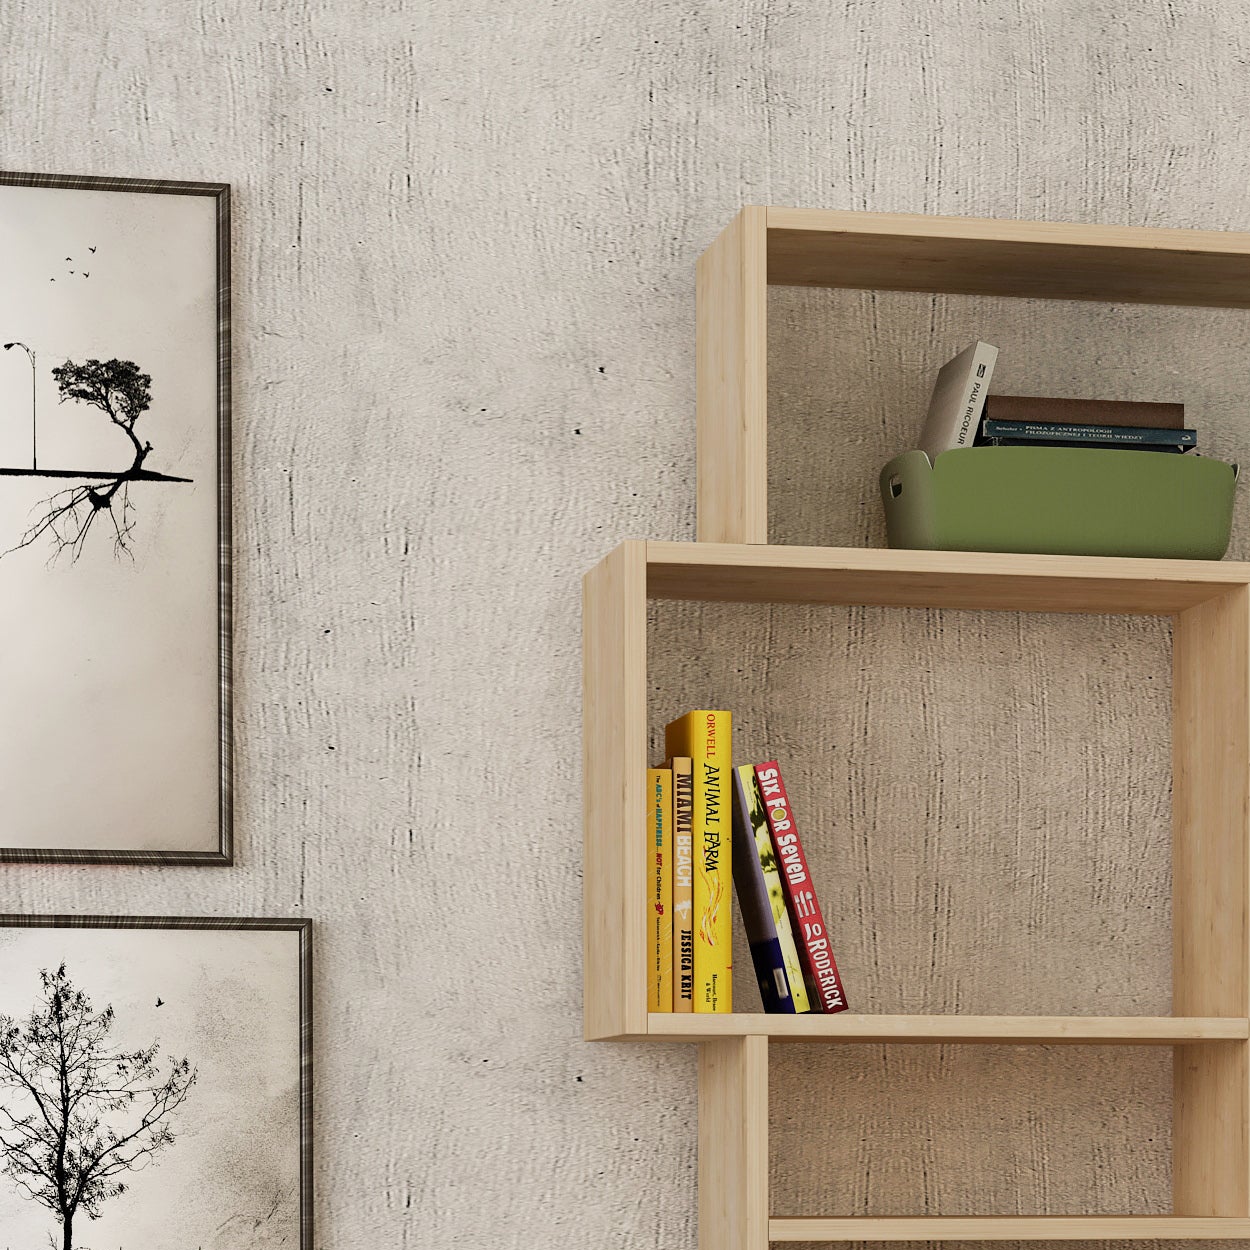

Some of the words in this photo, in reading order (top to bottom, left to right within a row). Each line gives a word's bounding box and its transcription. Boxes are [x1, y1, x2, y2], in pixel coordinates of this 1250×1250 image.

[969, 382, 981, 404] PAUL
[957, 406, 974, 445] RICOEUR
[706, 714, 716, 759] ORWELL
[676, 774, 692, 832] MIAMI
[704, 762, 720, 826] ANIMAL
[676, 835, 692, 886] BEACH
[704, 831, 721, 872] FARM
[681, 930, 692, 970] JESSICA
[808, 938, 843, 1010] RODERICK
